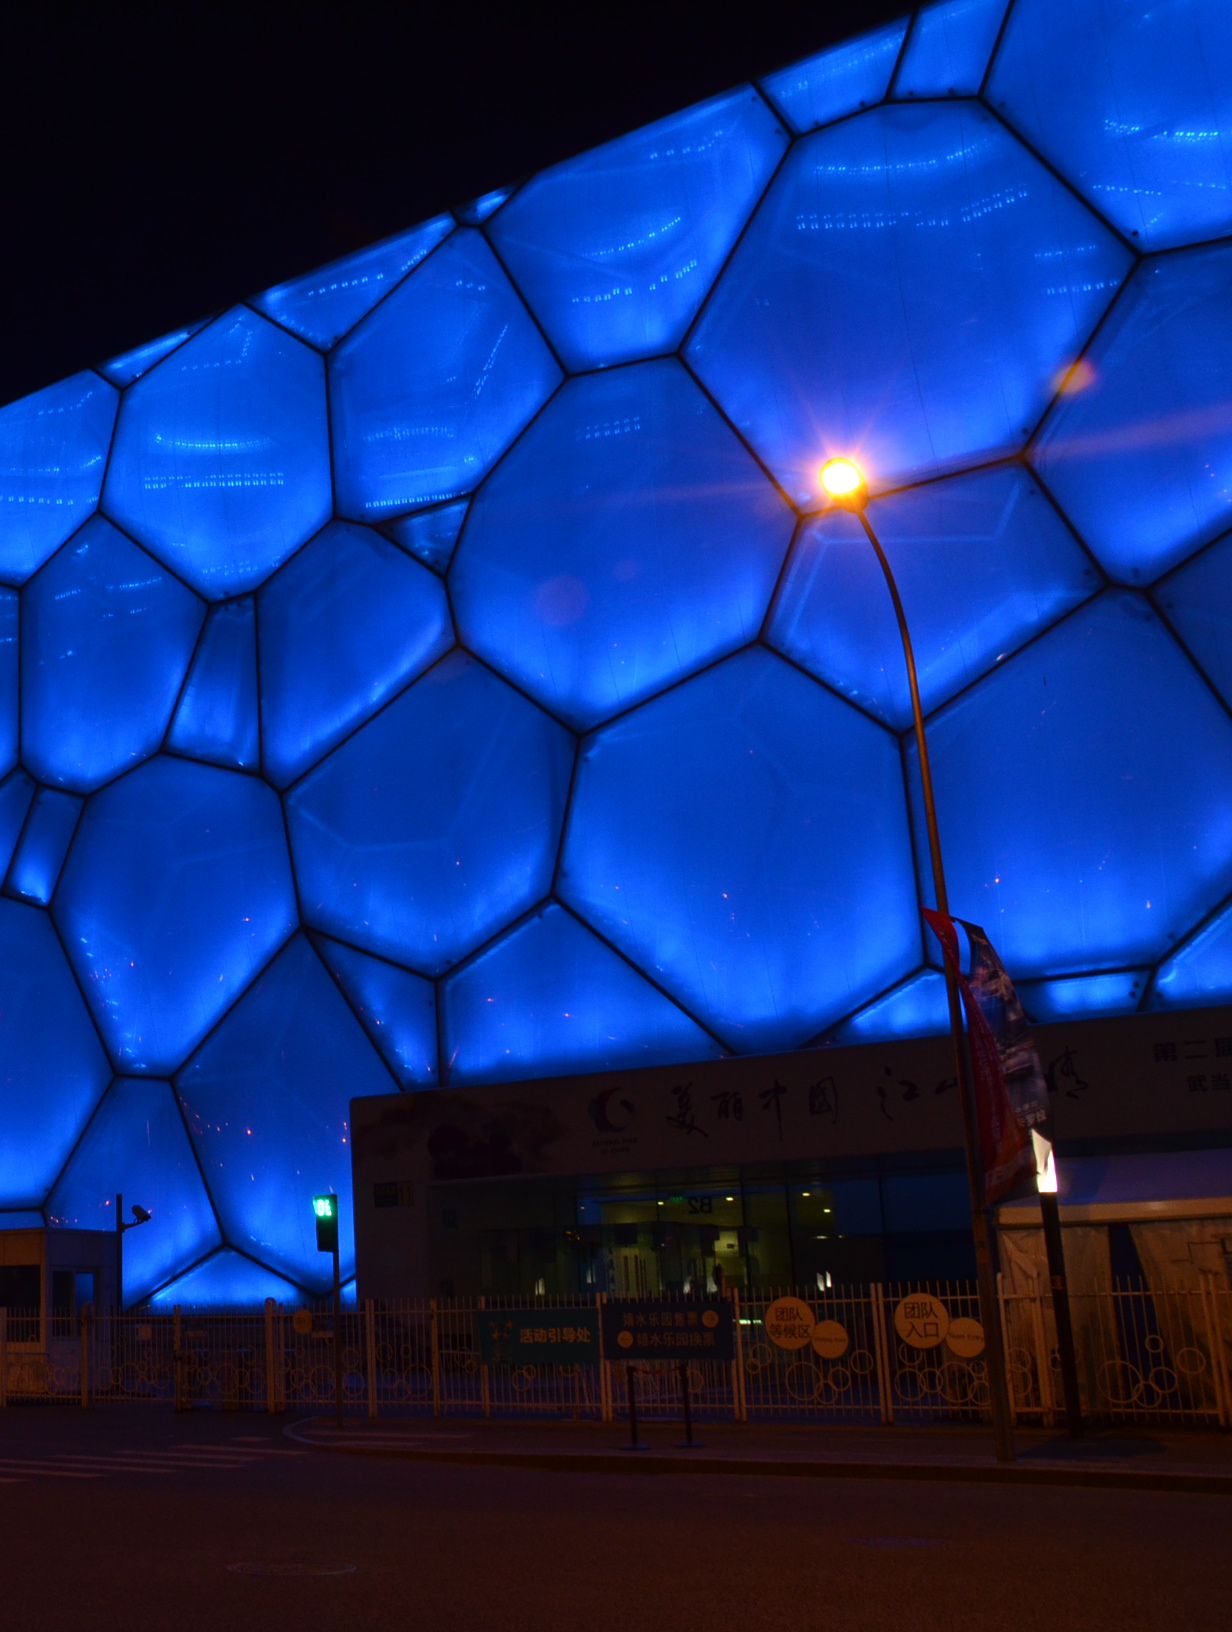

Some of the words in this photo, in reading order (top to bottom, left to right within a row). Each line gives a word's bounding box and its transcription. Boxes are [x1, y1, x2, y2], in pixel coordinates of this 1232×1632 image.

[775, 1306, 803, 1321] 团队
[904, 1302, 938, 1319] 团队
[519, 1327, 590, 1344] 活动引导处
[769, 1324, 810, 1339] 等候区
[906, 1323, 938, 1338] 入口
